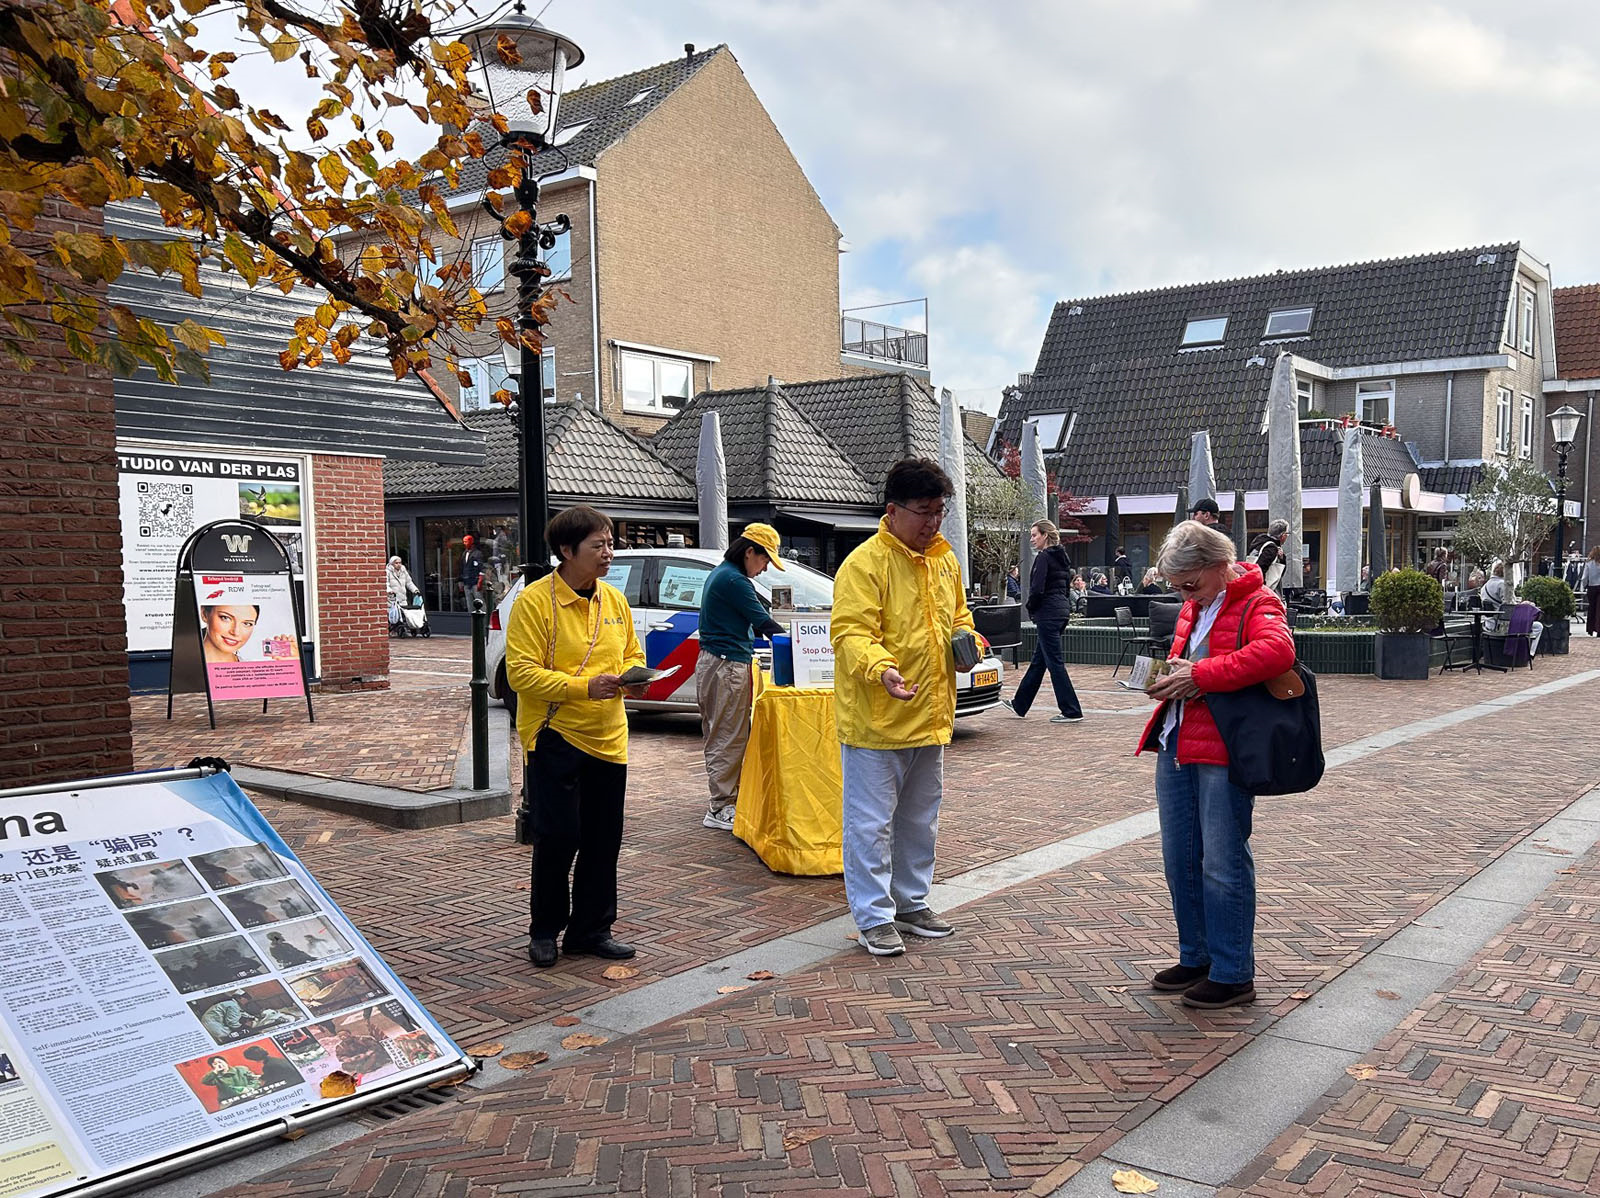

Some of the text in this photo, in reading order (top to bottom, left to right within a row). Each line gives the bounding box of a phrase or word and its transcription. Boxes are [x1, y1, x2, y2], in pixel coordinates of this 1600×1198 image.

[117, 456, 296, 478] TUDIO VAN DER PLAS
[800, 625, 826, 635] SIGN
[802, 647, 820, 655] Stop
[214, 1113, 235, 1123] Want
[271, 1088, 304, 1106] yourself?
